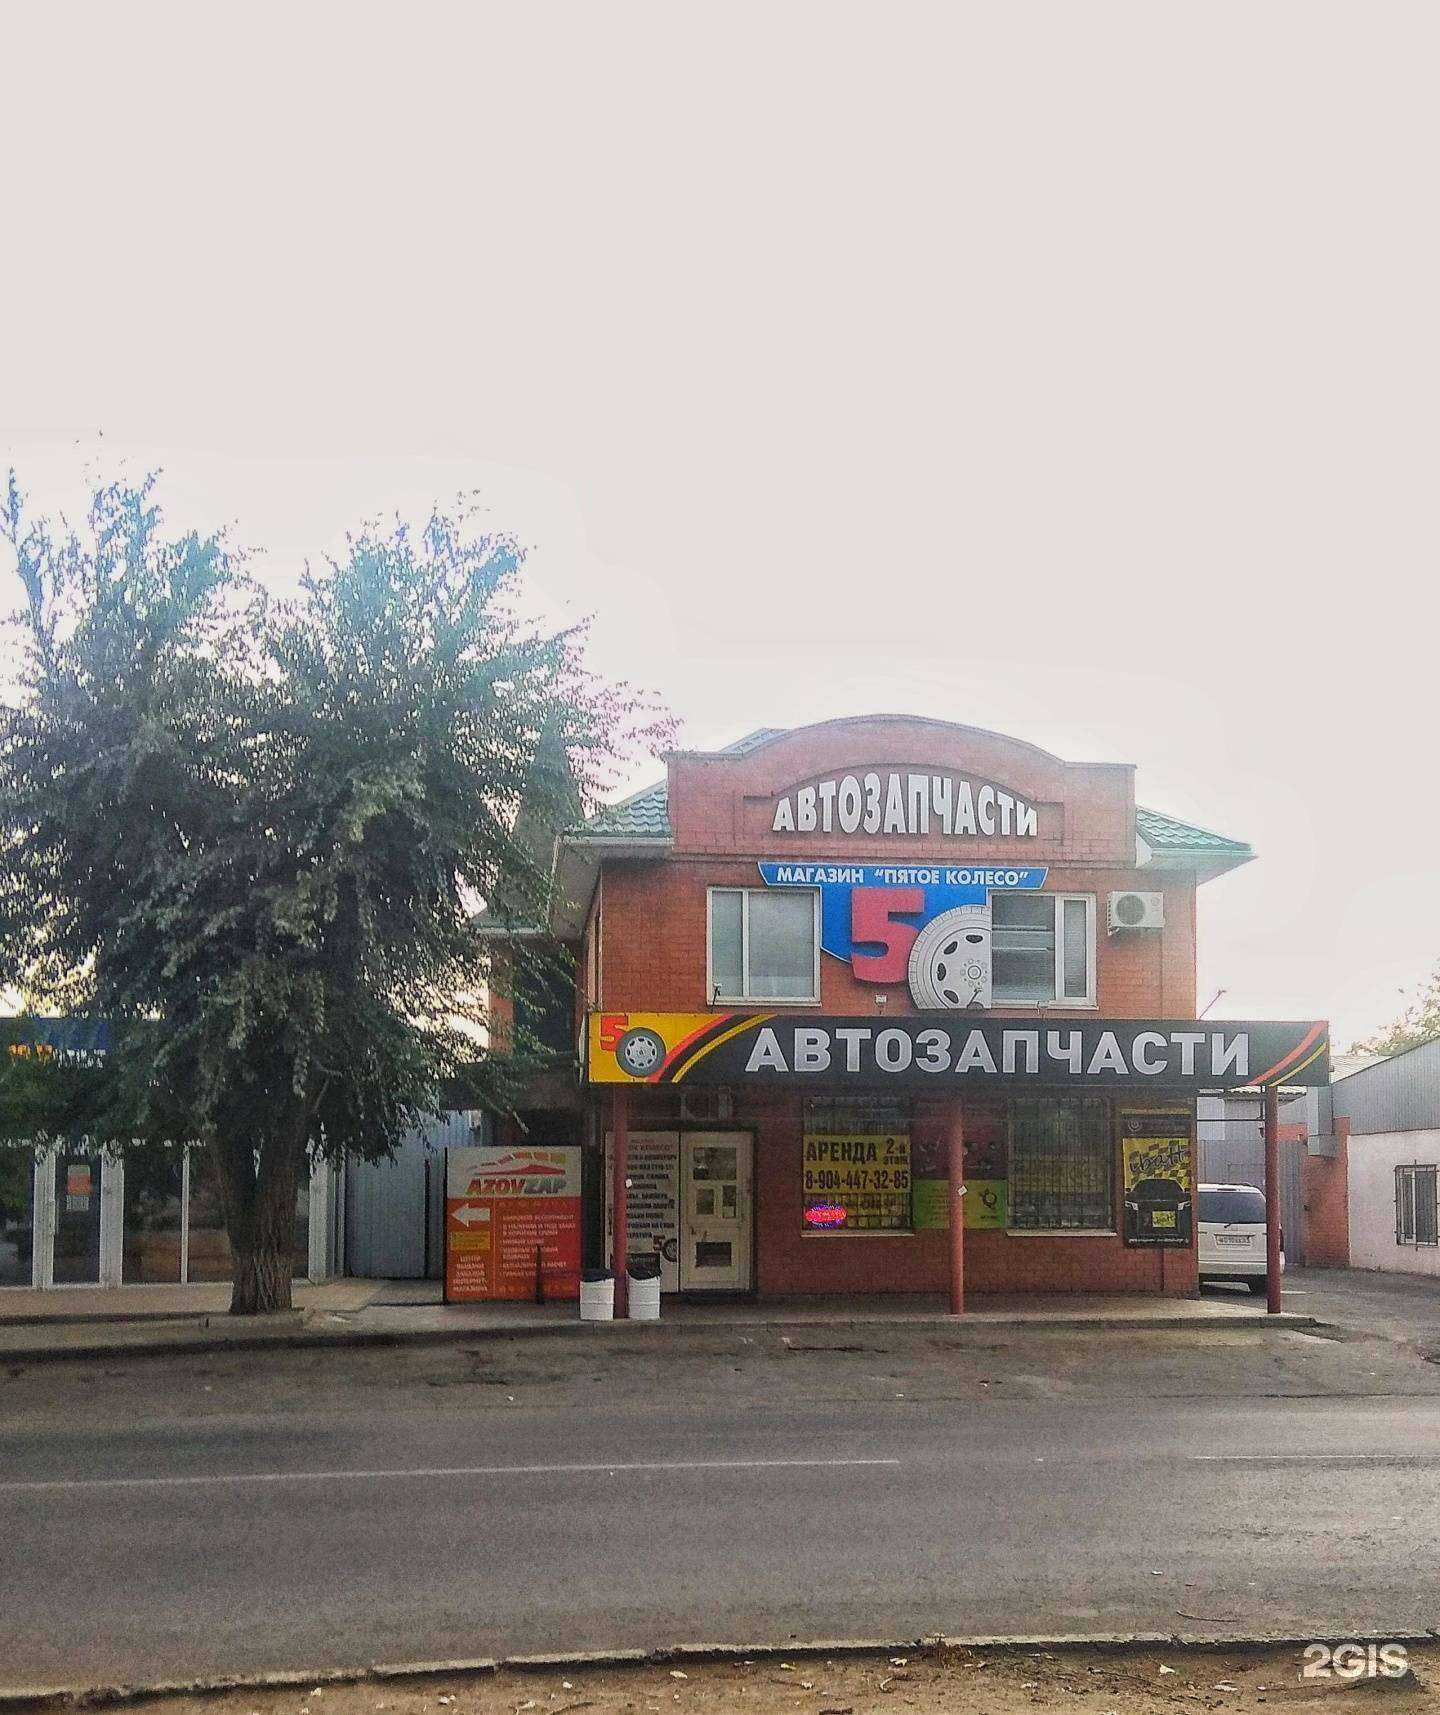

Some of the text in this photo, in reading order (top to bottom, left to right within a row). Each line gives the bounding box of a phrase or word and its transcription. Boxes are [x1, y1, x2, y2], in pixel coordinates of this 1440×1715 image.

[772, 772, 1039, 837] АВТОЗАПЧАСТИ
[776, 867, 864, 883] МАГАЗИН
[851, 887, 926, 984] 5
[600, 1014, 629, 1052] 5
[744, 1027, 1249, 1076] АВТОЗАПЧАСТИ
[804, 1141, 878, 1164] АРЕНДА
[465, 1177, 567, 1195] AZOVZAP
[804, 1169, 909, 1190] 8-904-447-32-85
